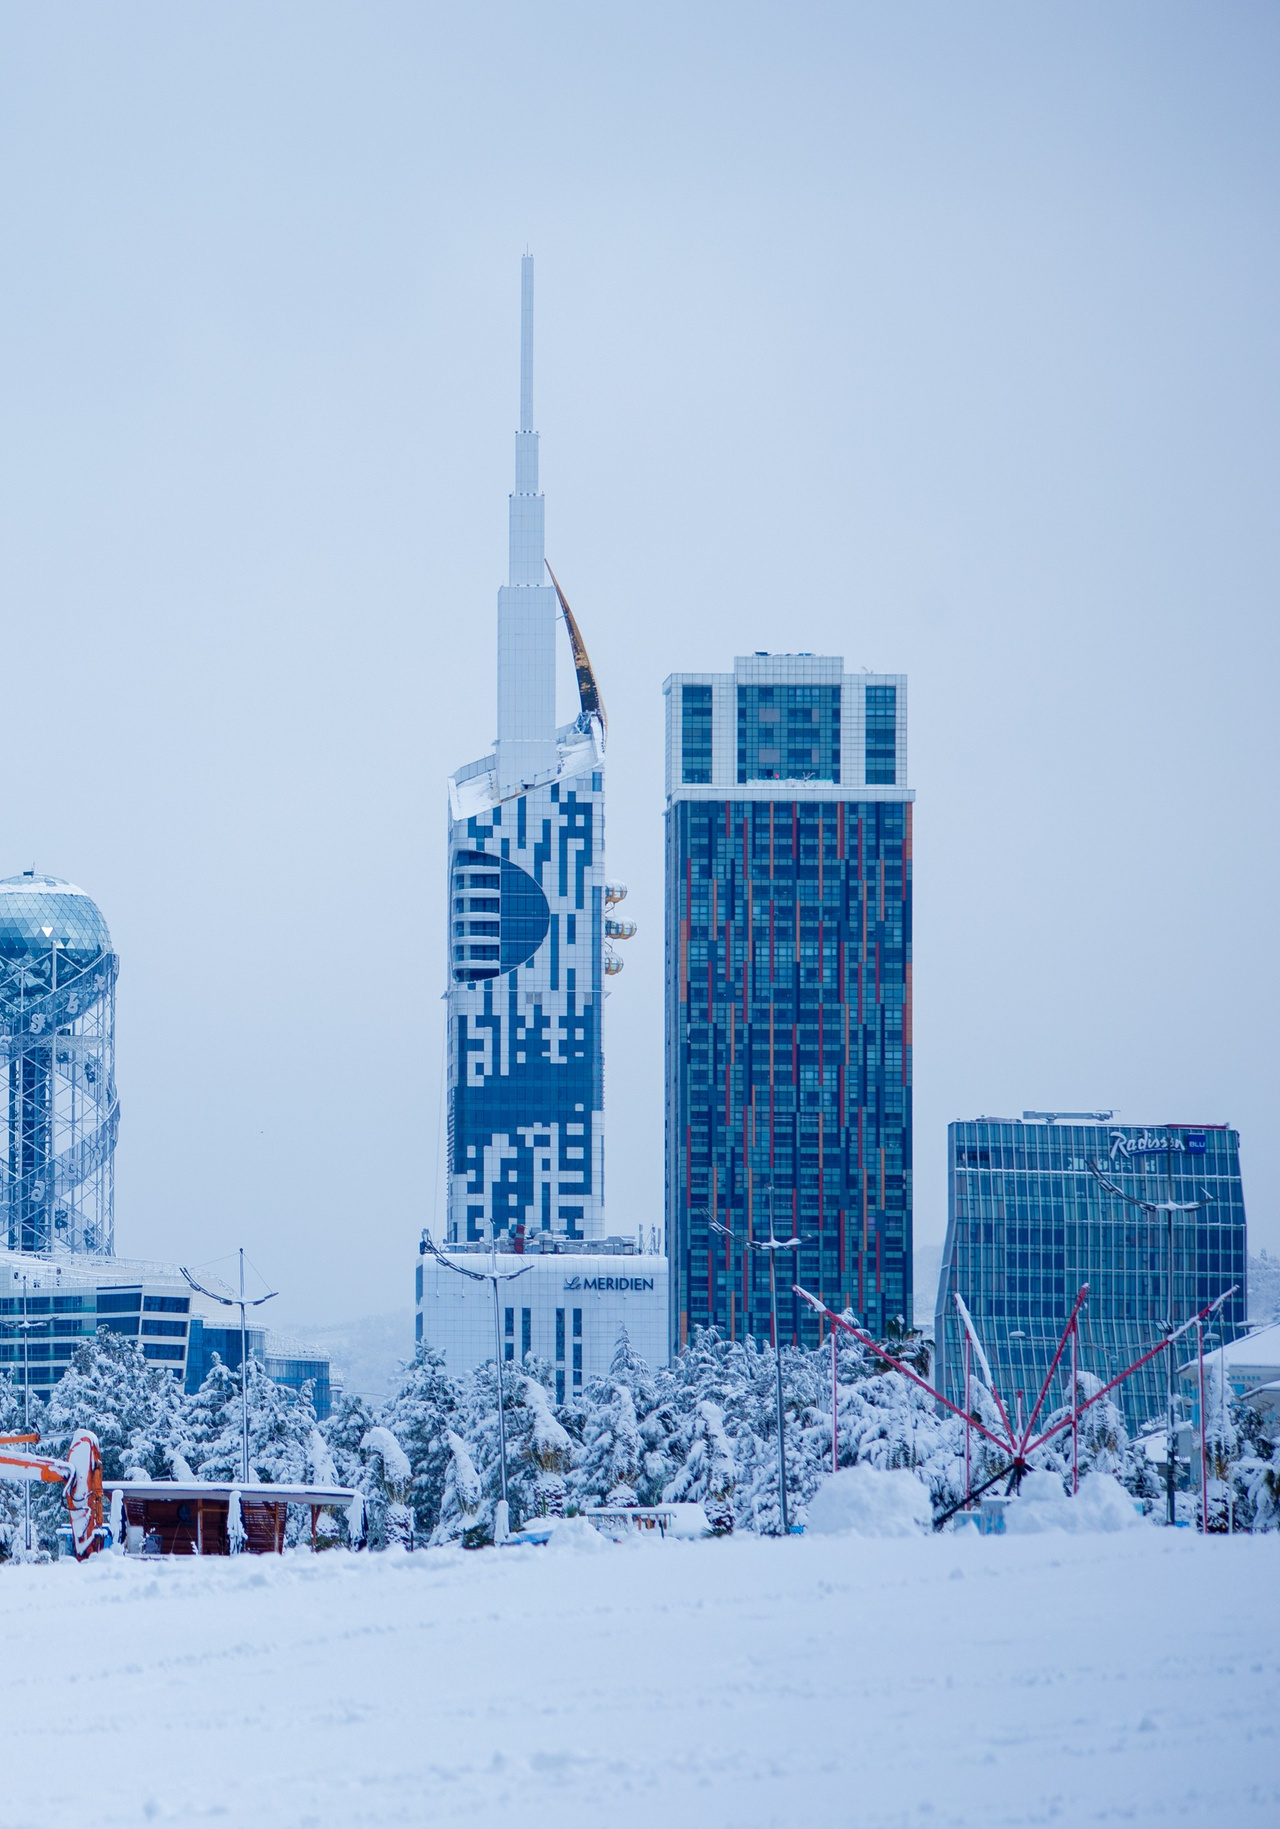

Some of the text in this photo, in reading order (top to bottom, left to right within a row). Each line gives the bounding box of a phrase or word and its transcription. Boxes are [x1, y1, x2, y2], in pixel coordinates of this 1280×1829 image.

[1189, 1140, 1205, 1148] BLU
[563, 1276, 654, 1291] Le MERIDIEN
